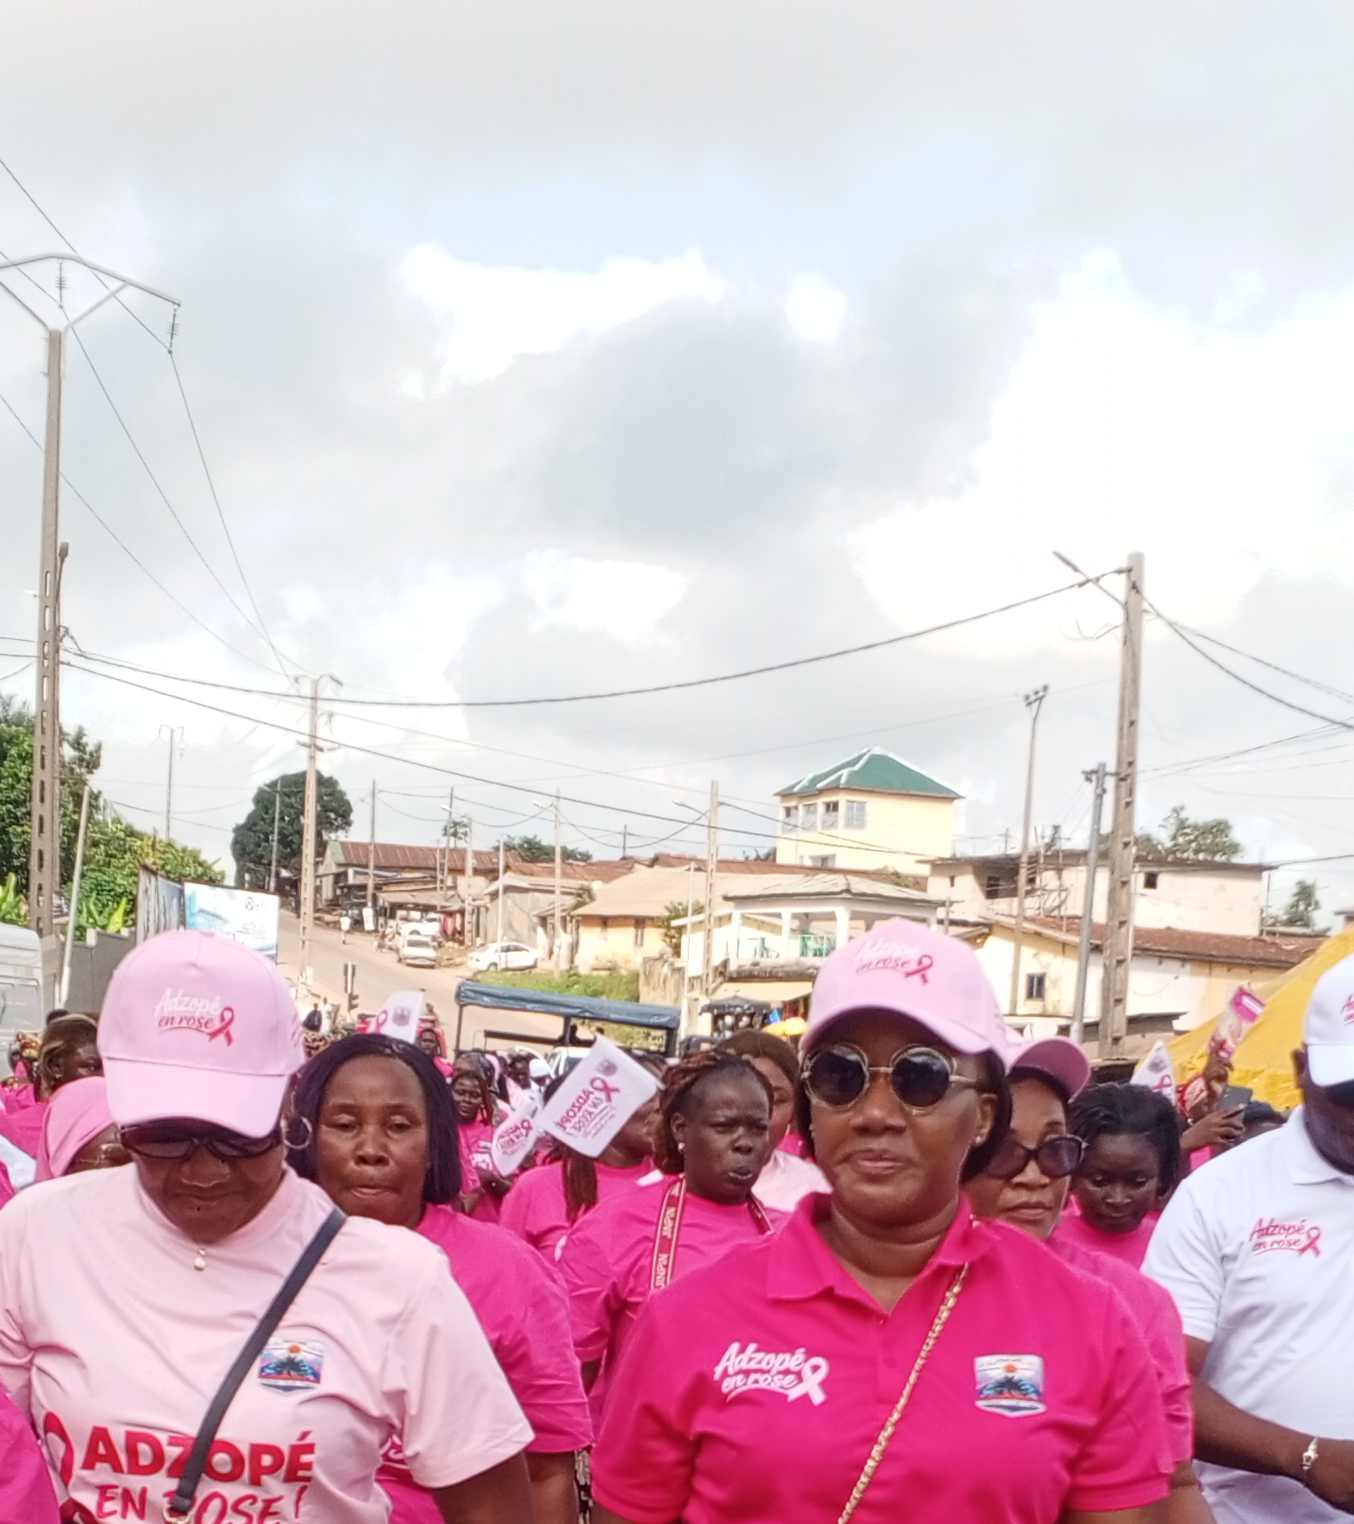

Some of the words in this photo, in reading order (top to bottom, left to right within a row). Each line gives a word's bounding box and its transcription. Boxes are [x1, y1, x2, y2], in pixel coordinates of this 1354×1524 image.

[154, 987, 221, 1018] Adzopé
[178, 1015, 213, 1029] rose
[713, 1341, 806, 1381] Adzopé
[721, 1373, 747, 1394] en
[746, 1372, 799, 1389] rose
[95, 1484, 148, 1521] EN
